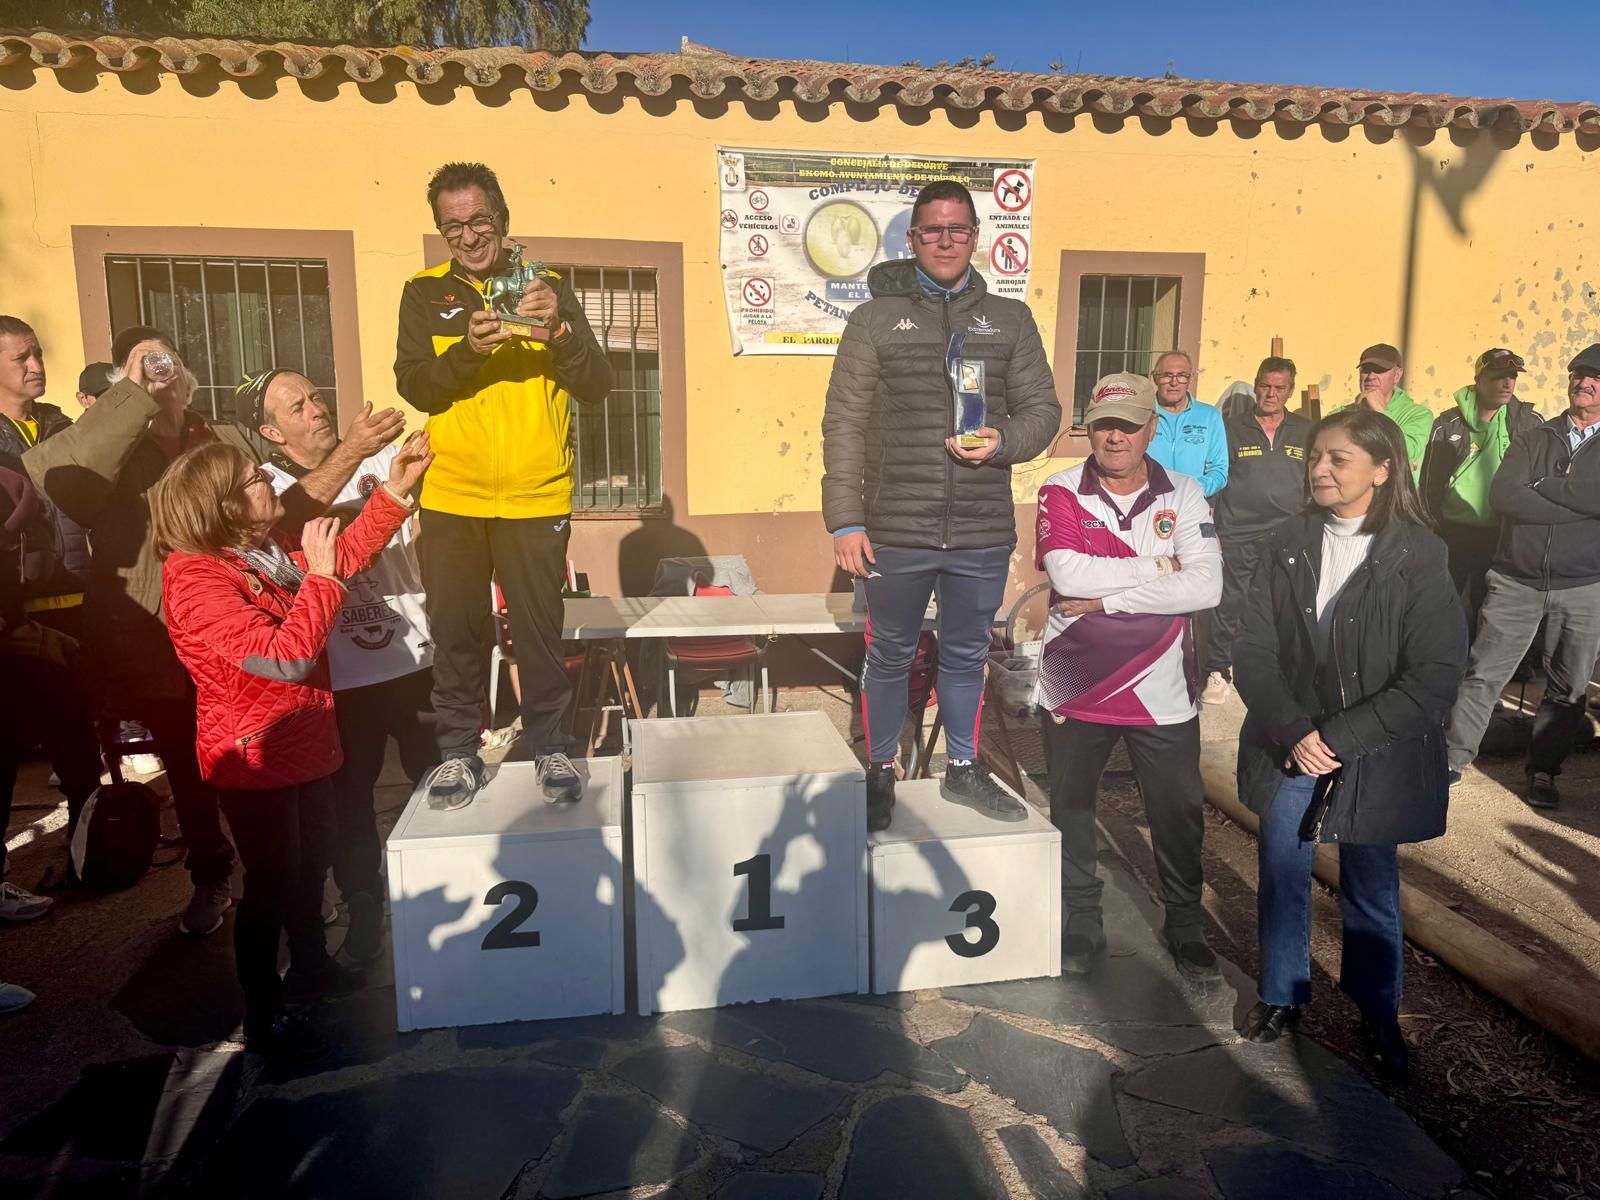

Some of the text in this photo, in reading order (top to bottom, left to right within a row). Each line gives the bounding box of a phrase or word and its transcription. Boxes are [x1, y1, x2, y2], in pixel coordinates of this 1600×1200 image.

[839, 171, 911, 180] AYUNTAMIENTO
[904, 160, 948, 170] DEPORTE
[809, 179, 892, 200] COMPLEJO
[831, 282, 868, 290] MANTE
[783, 336, 796, 344] EL
[342, 602, 397, 625] SABERE
[733, 854, 785, 931] 1
[481, 880, 541, 950] 2
[944, 890, 1000, 958] 3
